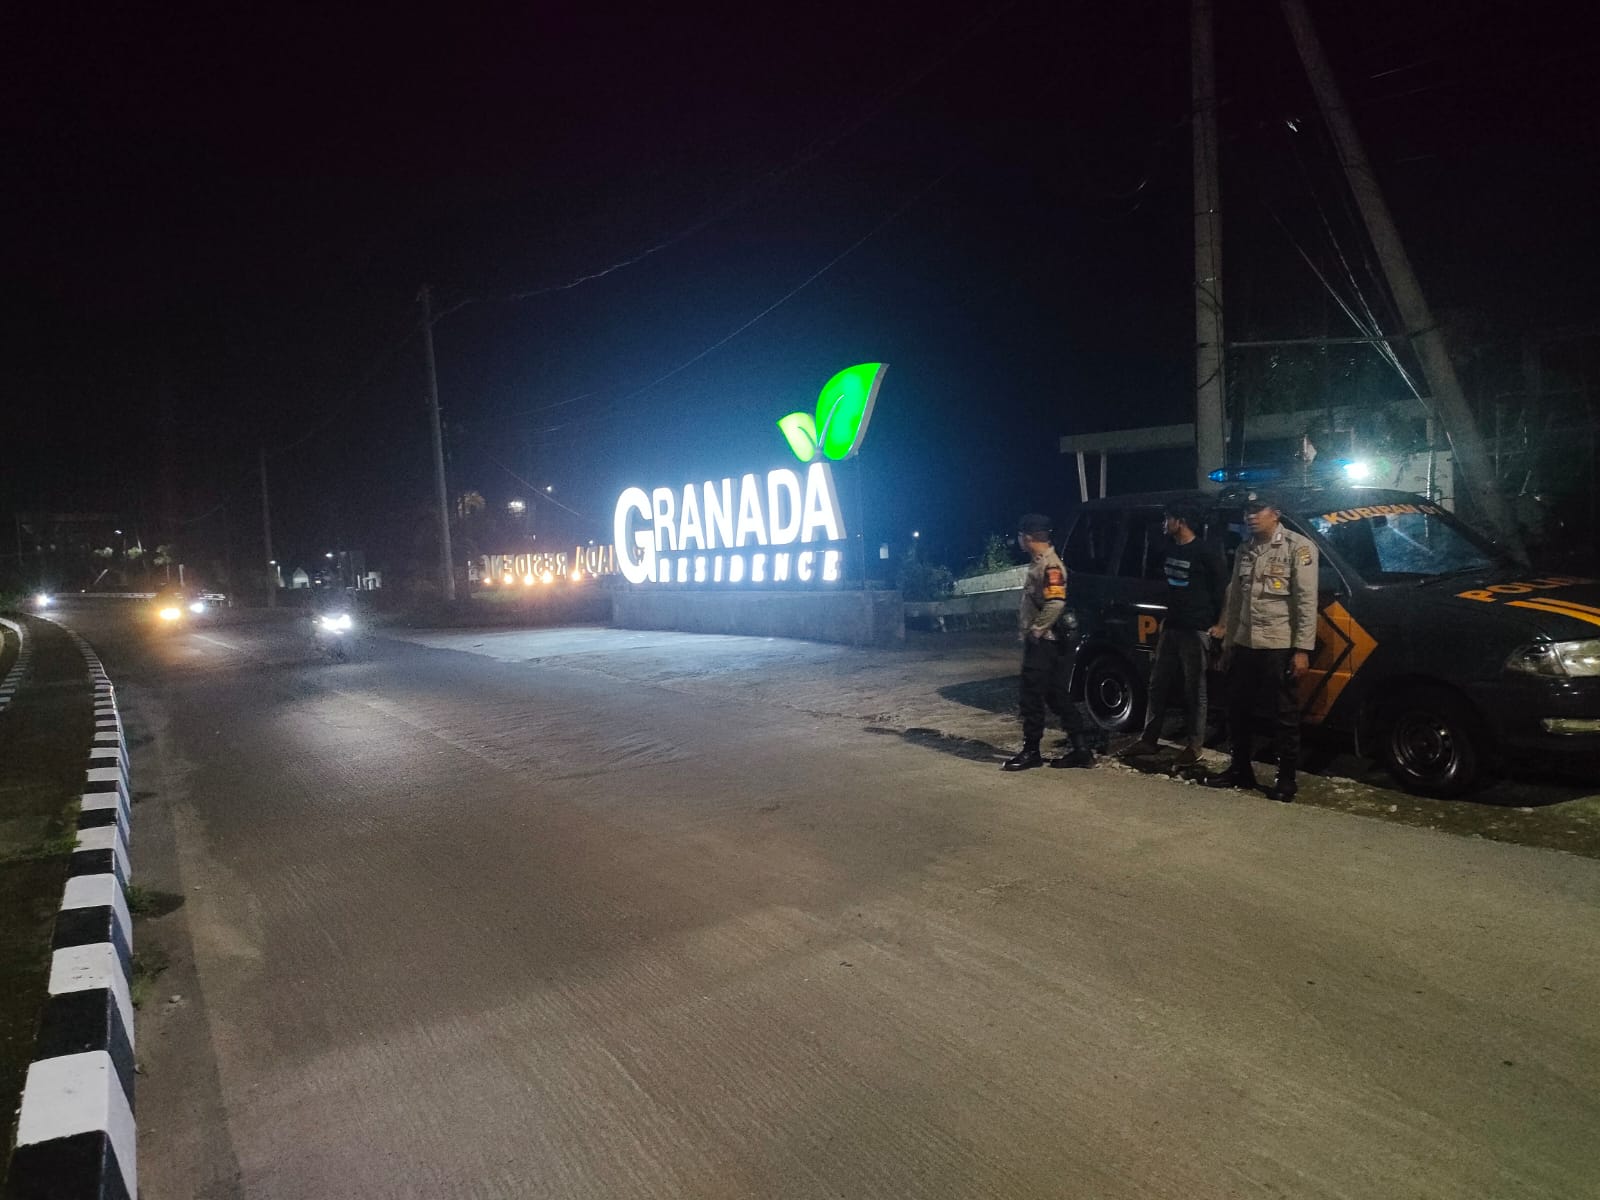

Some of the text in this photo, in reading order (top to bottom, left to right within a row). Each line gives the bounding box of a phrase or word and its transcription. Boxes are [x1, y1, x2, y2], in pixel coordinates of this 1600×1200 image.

[614, 462, 847, 584] GRANADA
[658, 550, 843, 583] RESIDENCE
[1454, 576, 1592, 604] POLI
